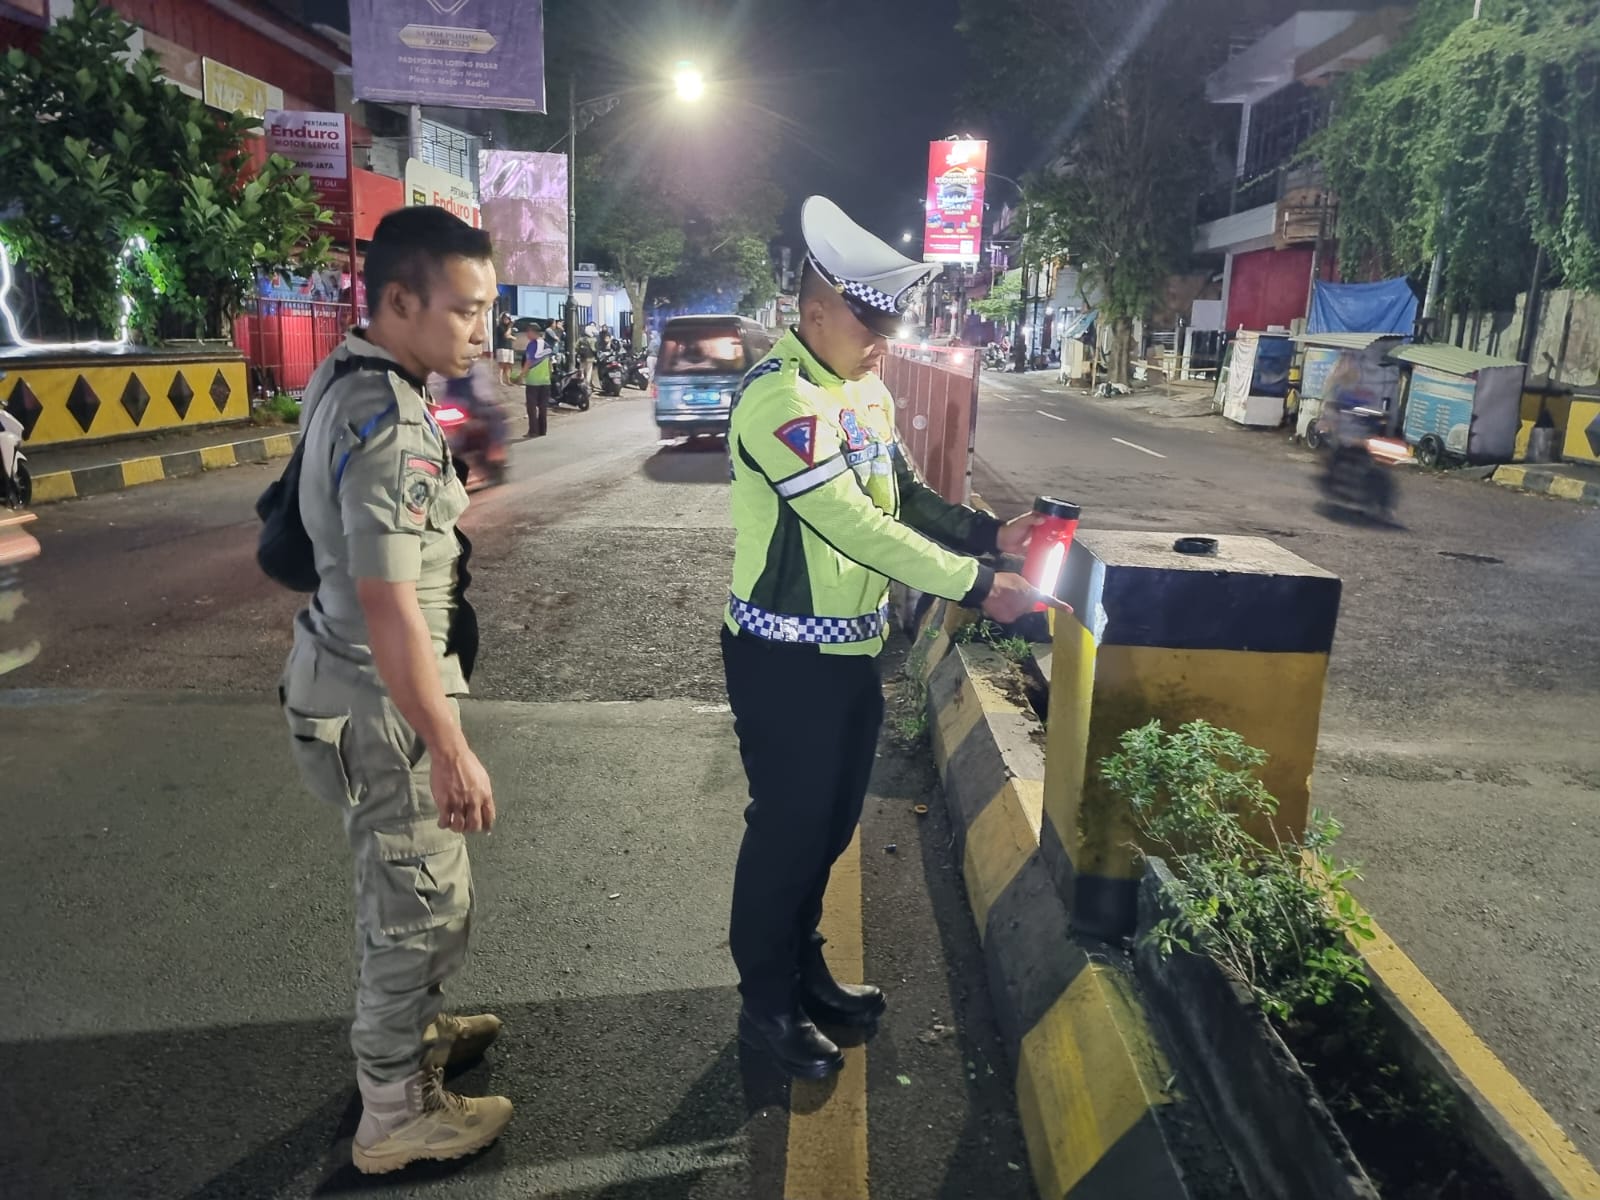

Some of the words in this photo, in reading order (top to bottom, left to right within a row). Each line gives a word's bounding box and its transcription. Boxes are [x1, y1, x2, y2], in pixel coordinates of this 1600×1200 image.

[398, 56, 443, 66] PADEPOKAN
[465, 79, 490, 88] Kediri
[270, 123, 339, 140] Enduro
[275, 140, 306, 149] MOTOR
[308, 141, 340, 150] SERVICE
[315, 161, 335, 170] JAYA
[433, 191, 470, 220] Enduro
